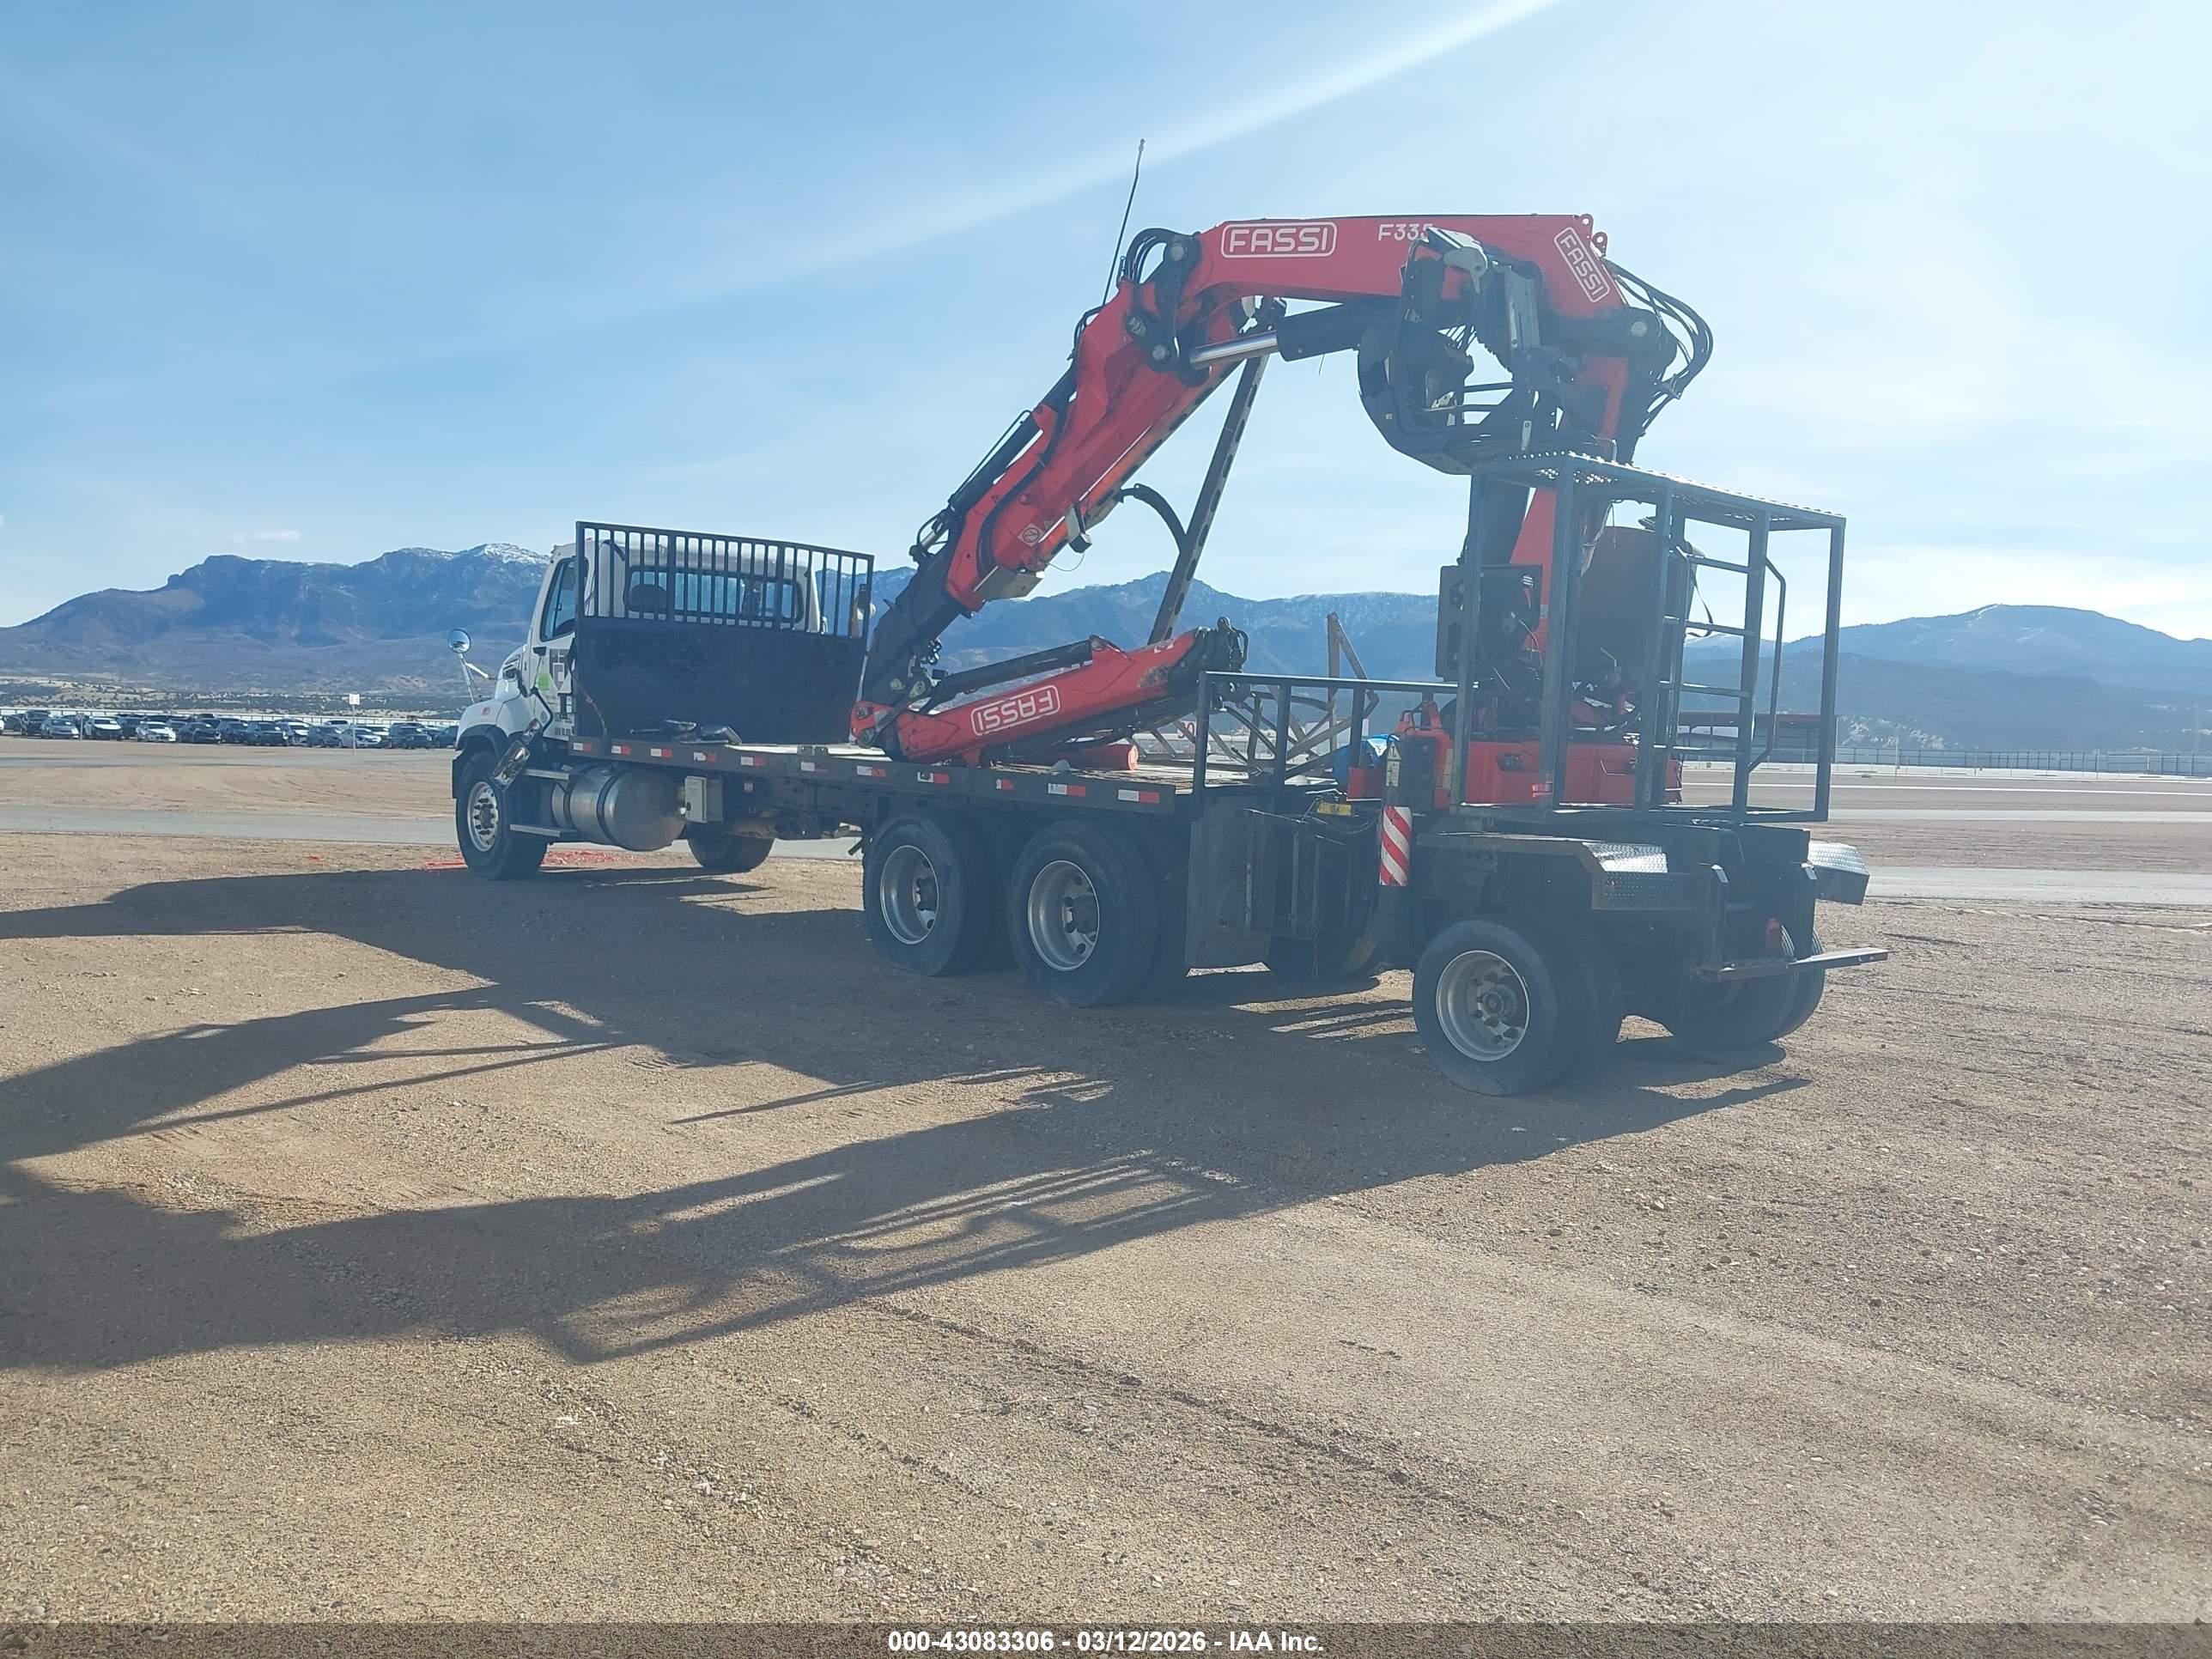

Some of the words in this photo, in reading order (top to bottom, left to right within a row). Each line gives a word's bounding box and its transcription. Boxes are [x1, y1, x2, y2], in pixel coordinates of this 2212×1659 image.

[1229, 227, 1328, 252] FASSI
[1559, 234, 1604, 296] FASSI
[977, 690, 1054, 731] FASSI
